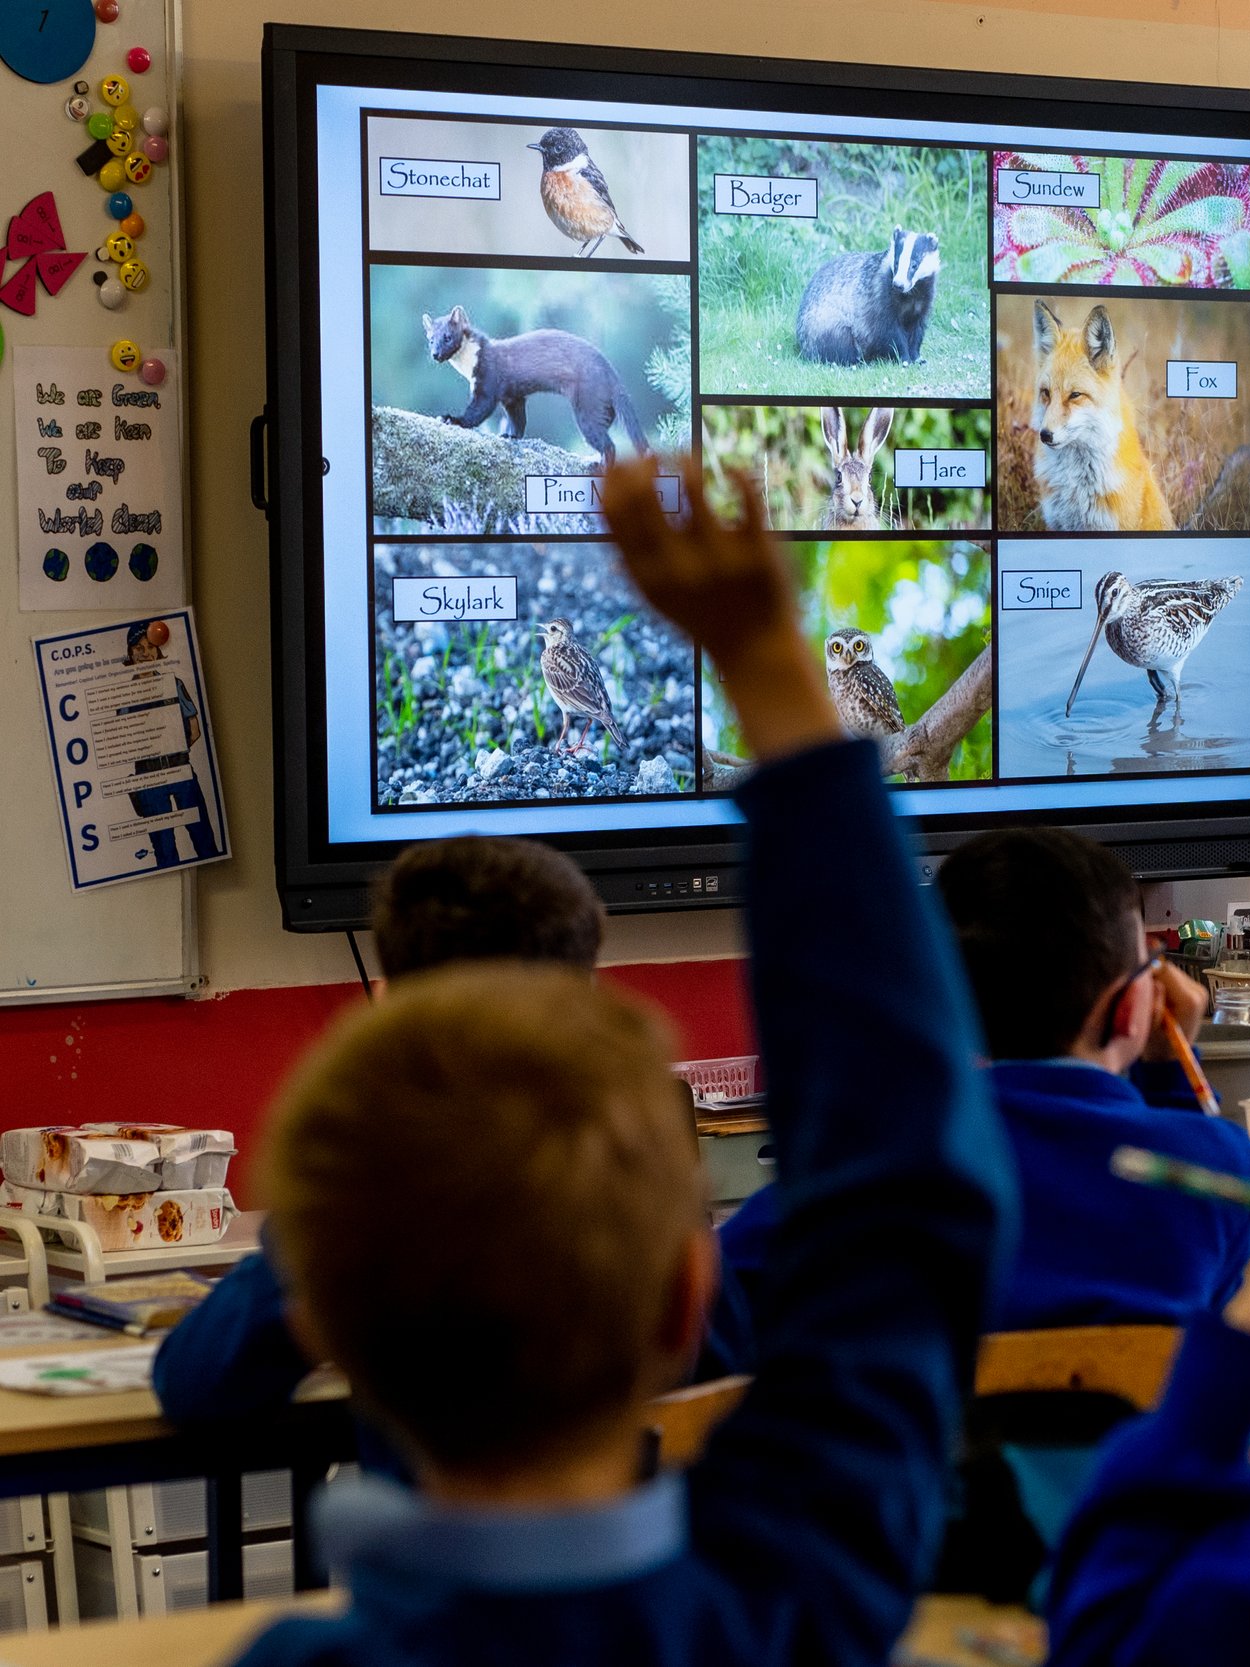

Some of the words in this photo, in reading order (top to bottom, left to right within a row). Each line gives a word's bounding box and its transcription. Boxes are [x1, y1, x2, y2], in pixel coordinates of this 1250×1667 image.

[387, 162, 490, 189] Stonechat
[1012, 172, 1085, 199] Sundew
[730, 179, 802, 213] Badger
[1185, 366, 1218, 392] Fox
[36, 383, 65, 405] We
[76, 389, 103, 407] are
[37, 417, 63, 438] We
[75, 421, 102, 440] are
[114, 415, 151, 441] Keen
[37, 447, 67, 474] To
[85, 449, 125, 485] Keep
[919, 454, 967, 481] Hare
[66, 480, 103, 501] our
[543, 478, 585, 506] Pine
[37, 506, 103, 537] World
[111, 503, 162, 535] Clean
[419, 585, 504, 620] Skylark
[1016, 576, 1071, 608] Snipe
[51, 643, 96, 662] C.O.P.S.
[58, 694, 80, 722] C
[66, 737, 88, 765] O
[73, 780, 93, 808] P
[80, 824, 100, 852] S
